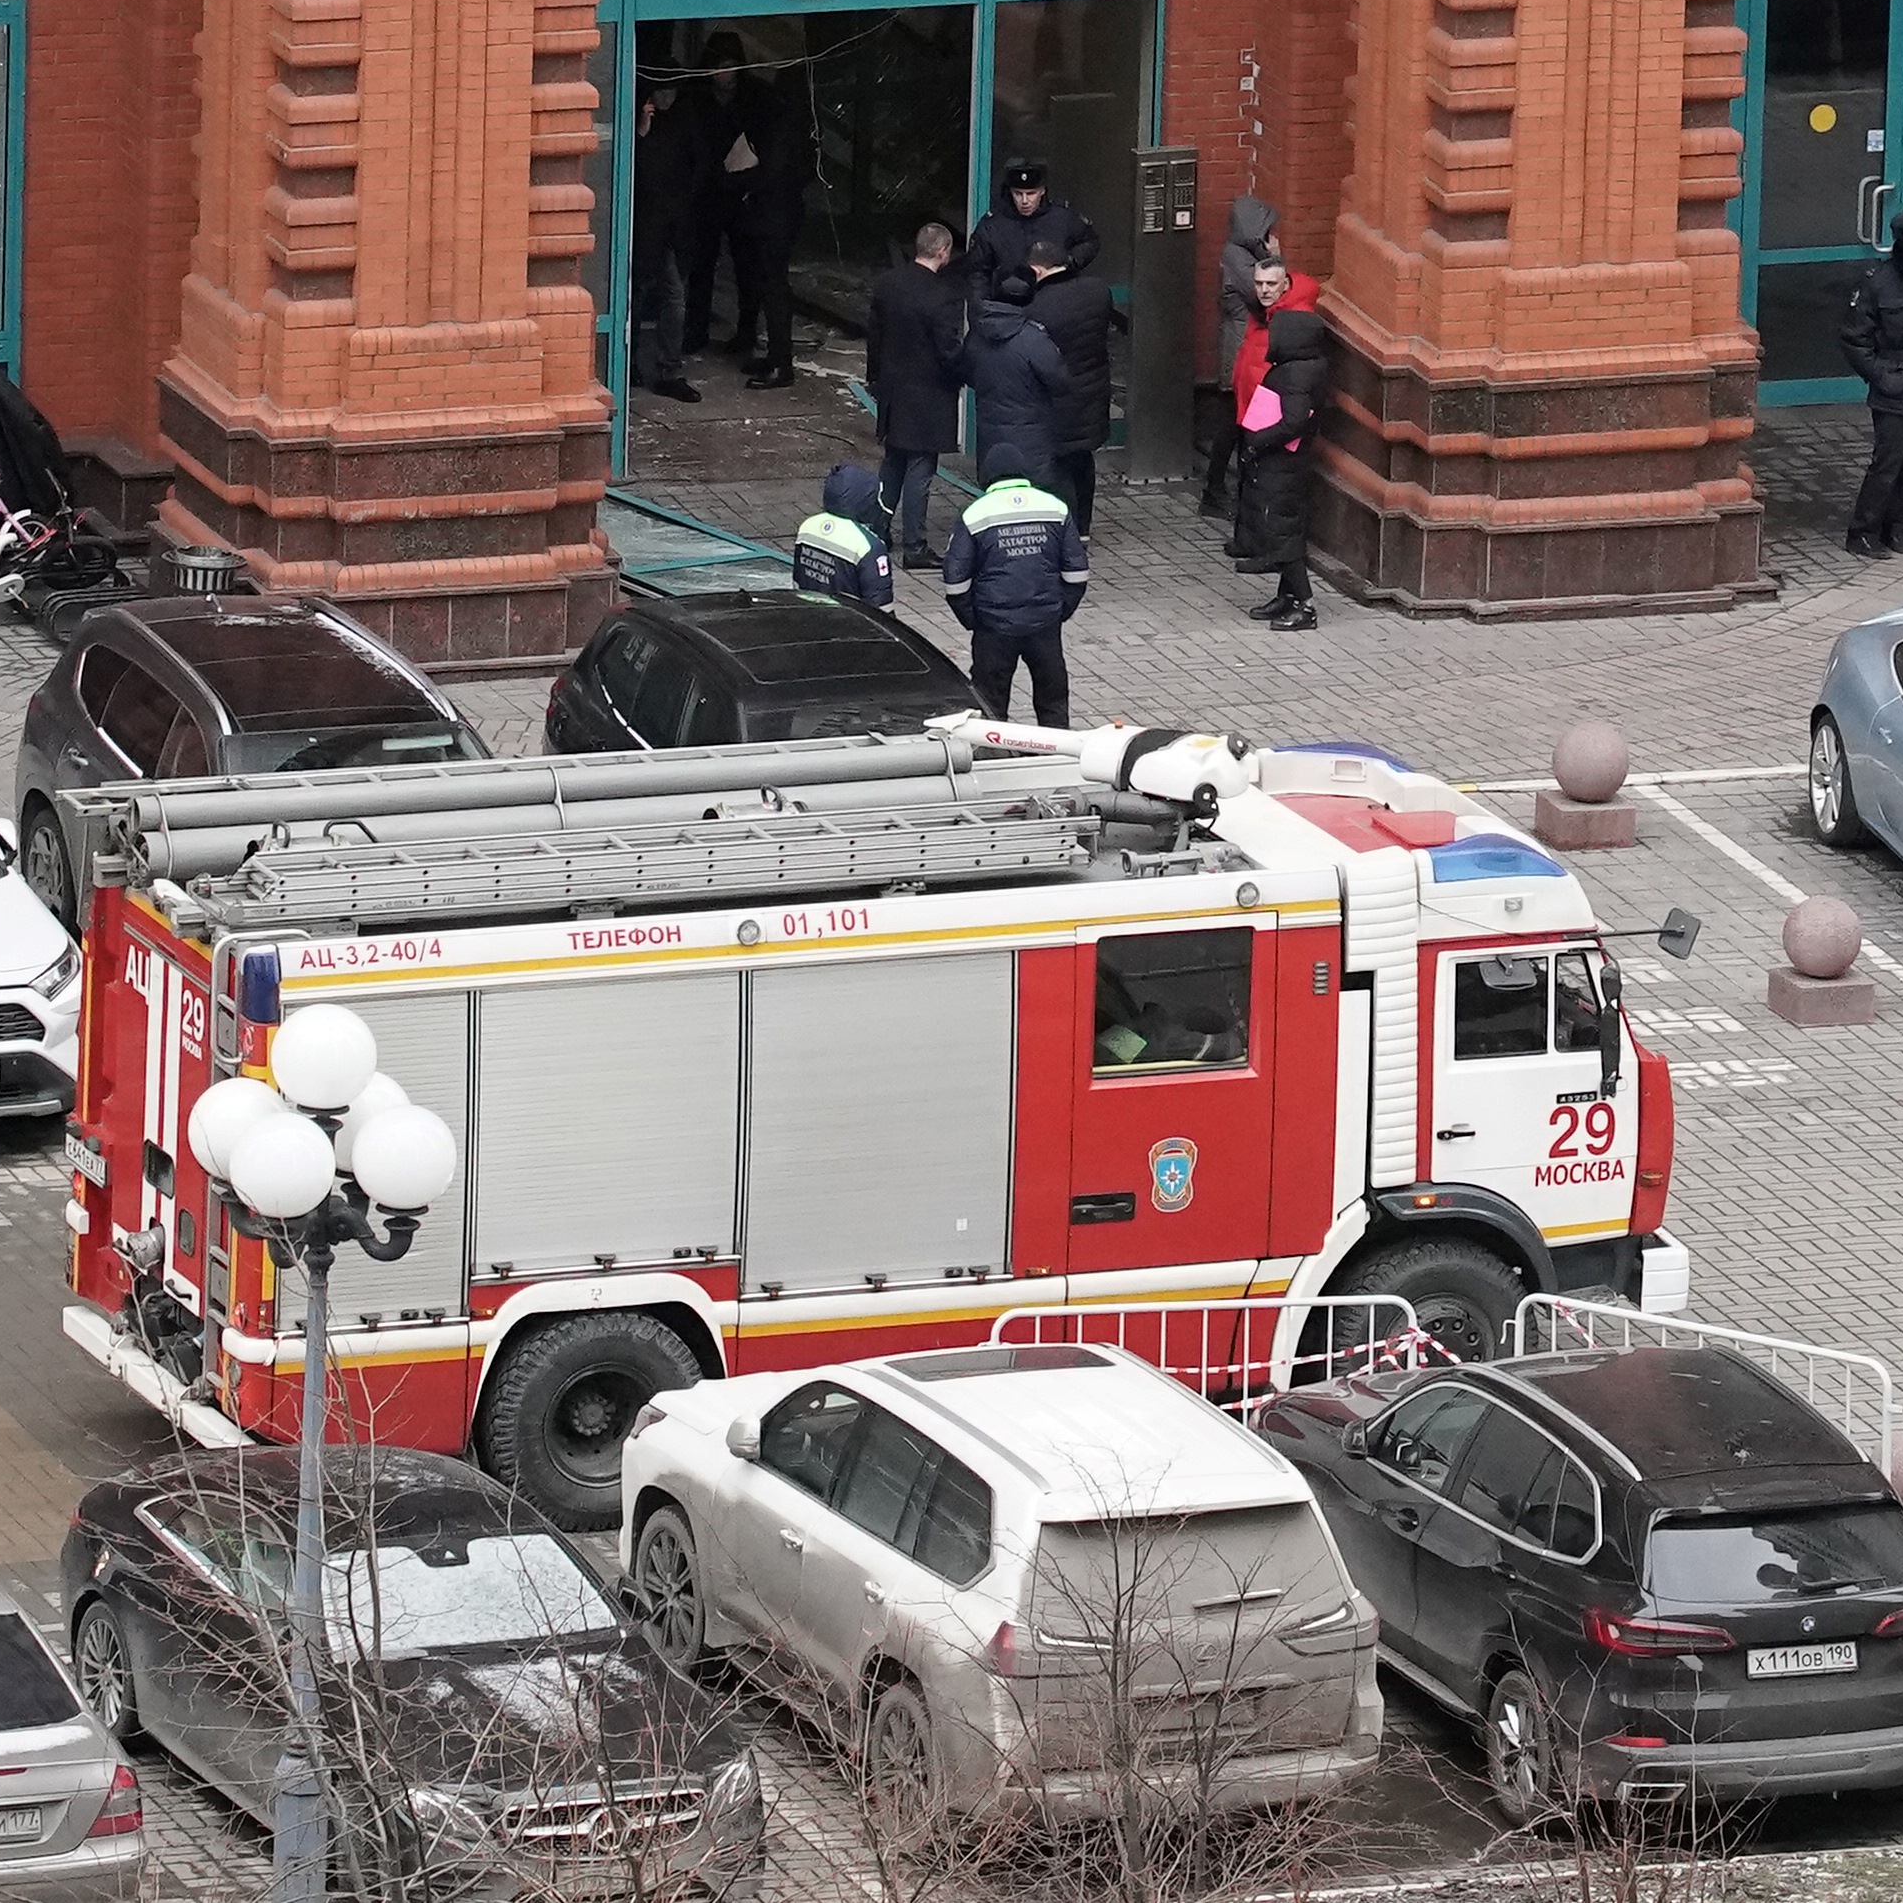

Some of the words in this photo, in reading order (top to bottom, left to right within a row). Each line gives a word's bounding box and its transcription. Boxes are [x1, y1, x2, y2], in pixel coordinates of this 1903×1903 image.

[1005, 546, 1042, 558] МОСКВА
[301, 938, 443, 970] АЦ-3,2-40/4
[567, 925, 682, 951] ТЕЛЕФОН
[124, 944, 150, 1006] АЦ
[182, 989, 205, 1042] 29
[1549, 1102, 1615, 1159] 29
[1535, 1159, 1625, 1187] МОСКВА
